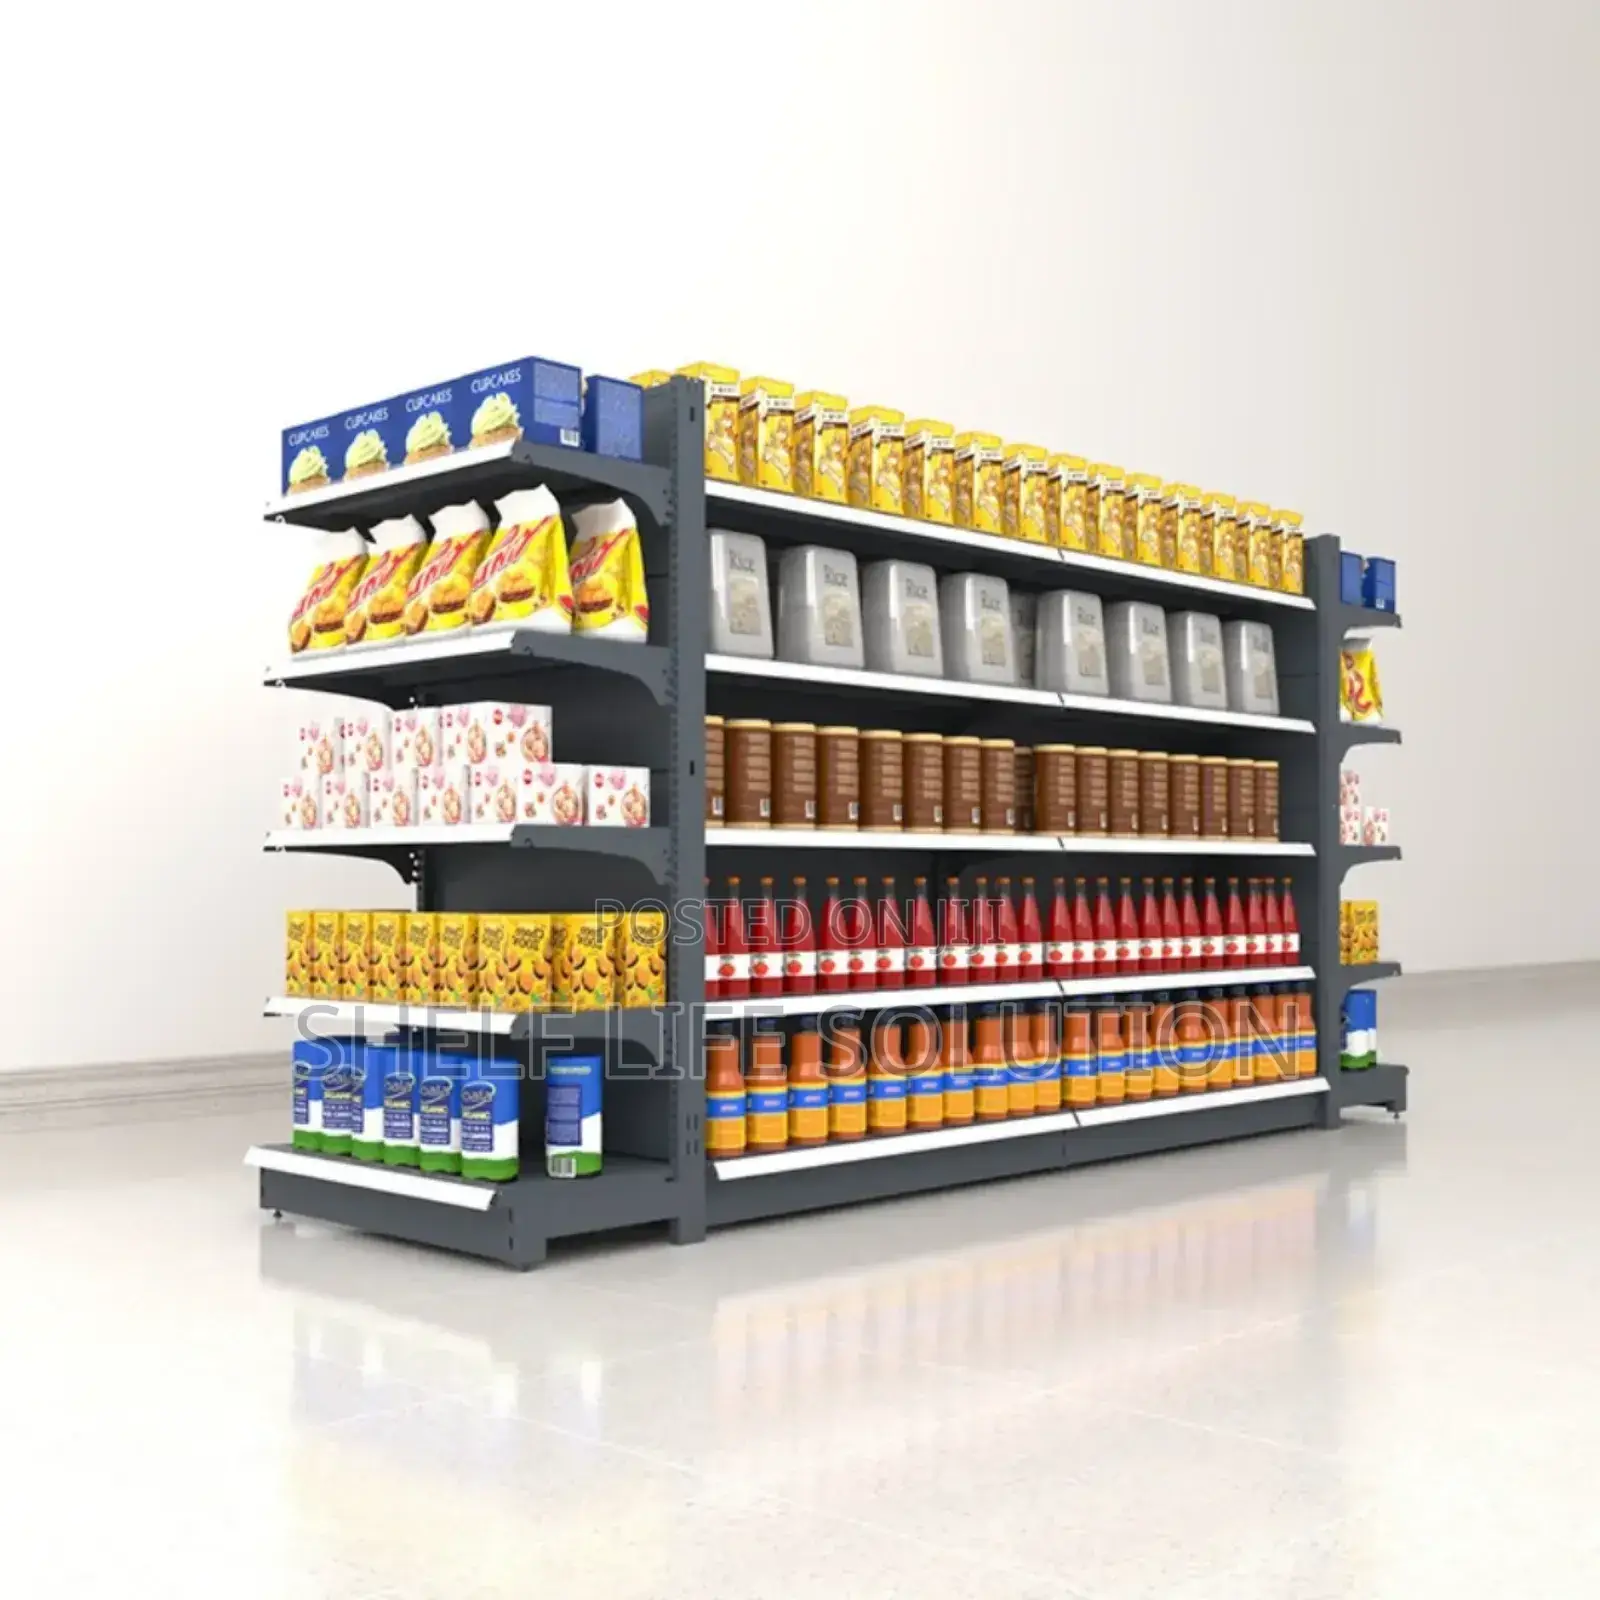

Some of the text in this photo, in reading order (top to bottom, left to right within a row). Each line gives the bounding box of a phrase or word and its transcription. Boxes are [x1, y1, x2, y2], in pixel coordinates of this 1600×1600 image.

[470, 367, 522, 394] CUPCAKES
[404, 388, 453, 413] CUPCAKES
[344, 407, 389, 431] CUPCAKES
[287, 424, 330, 447] CUPCAKES
[729, 549, 756, 574] Rice
[823, 564, 848, 588] Rice
[905, 578, 928, 600] Rice
